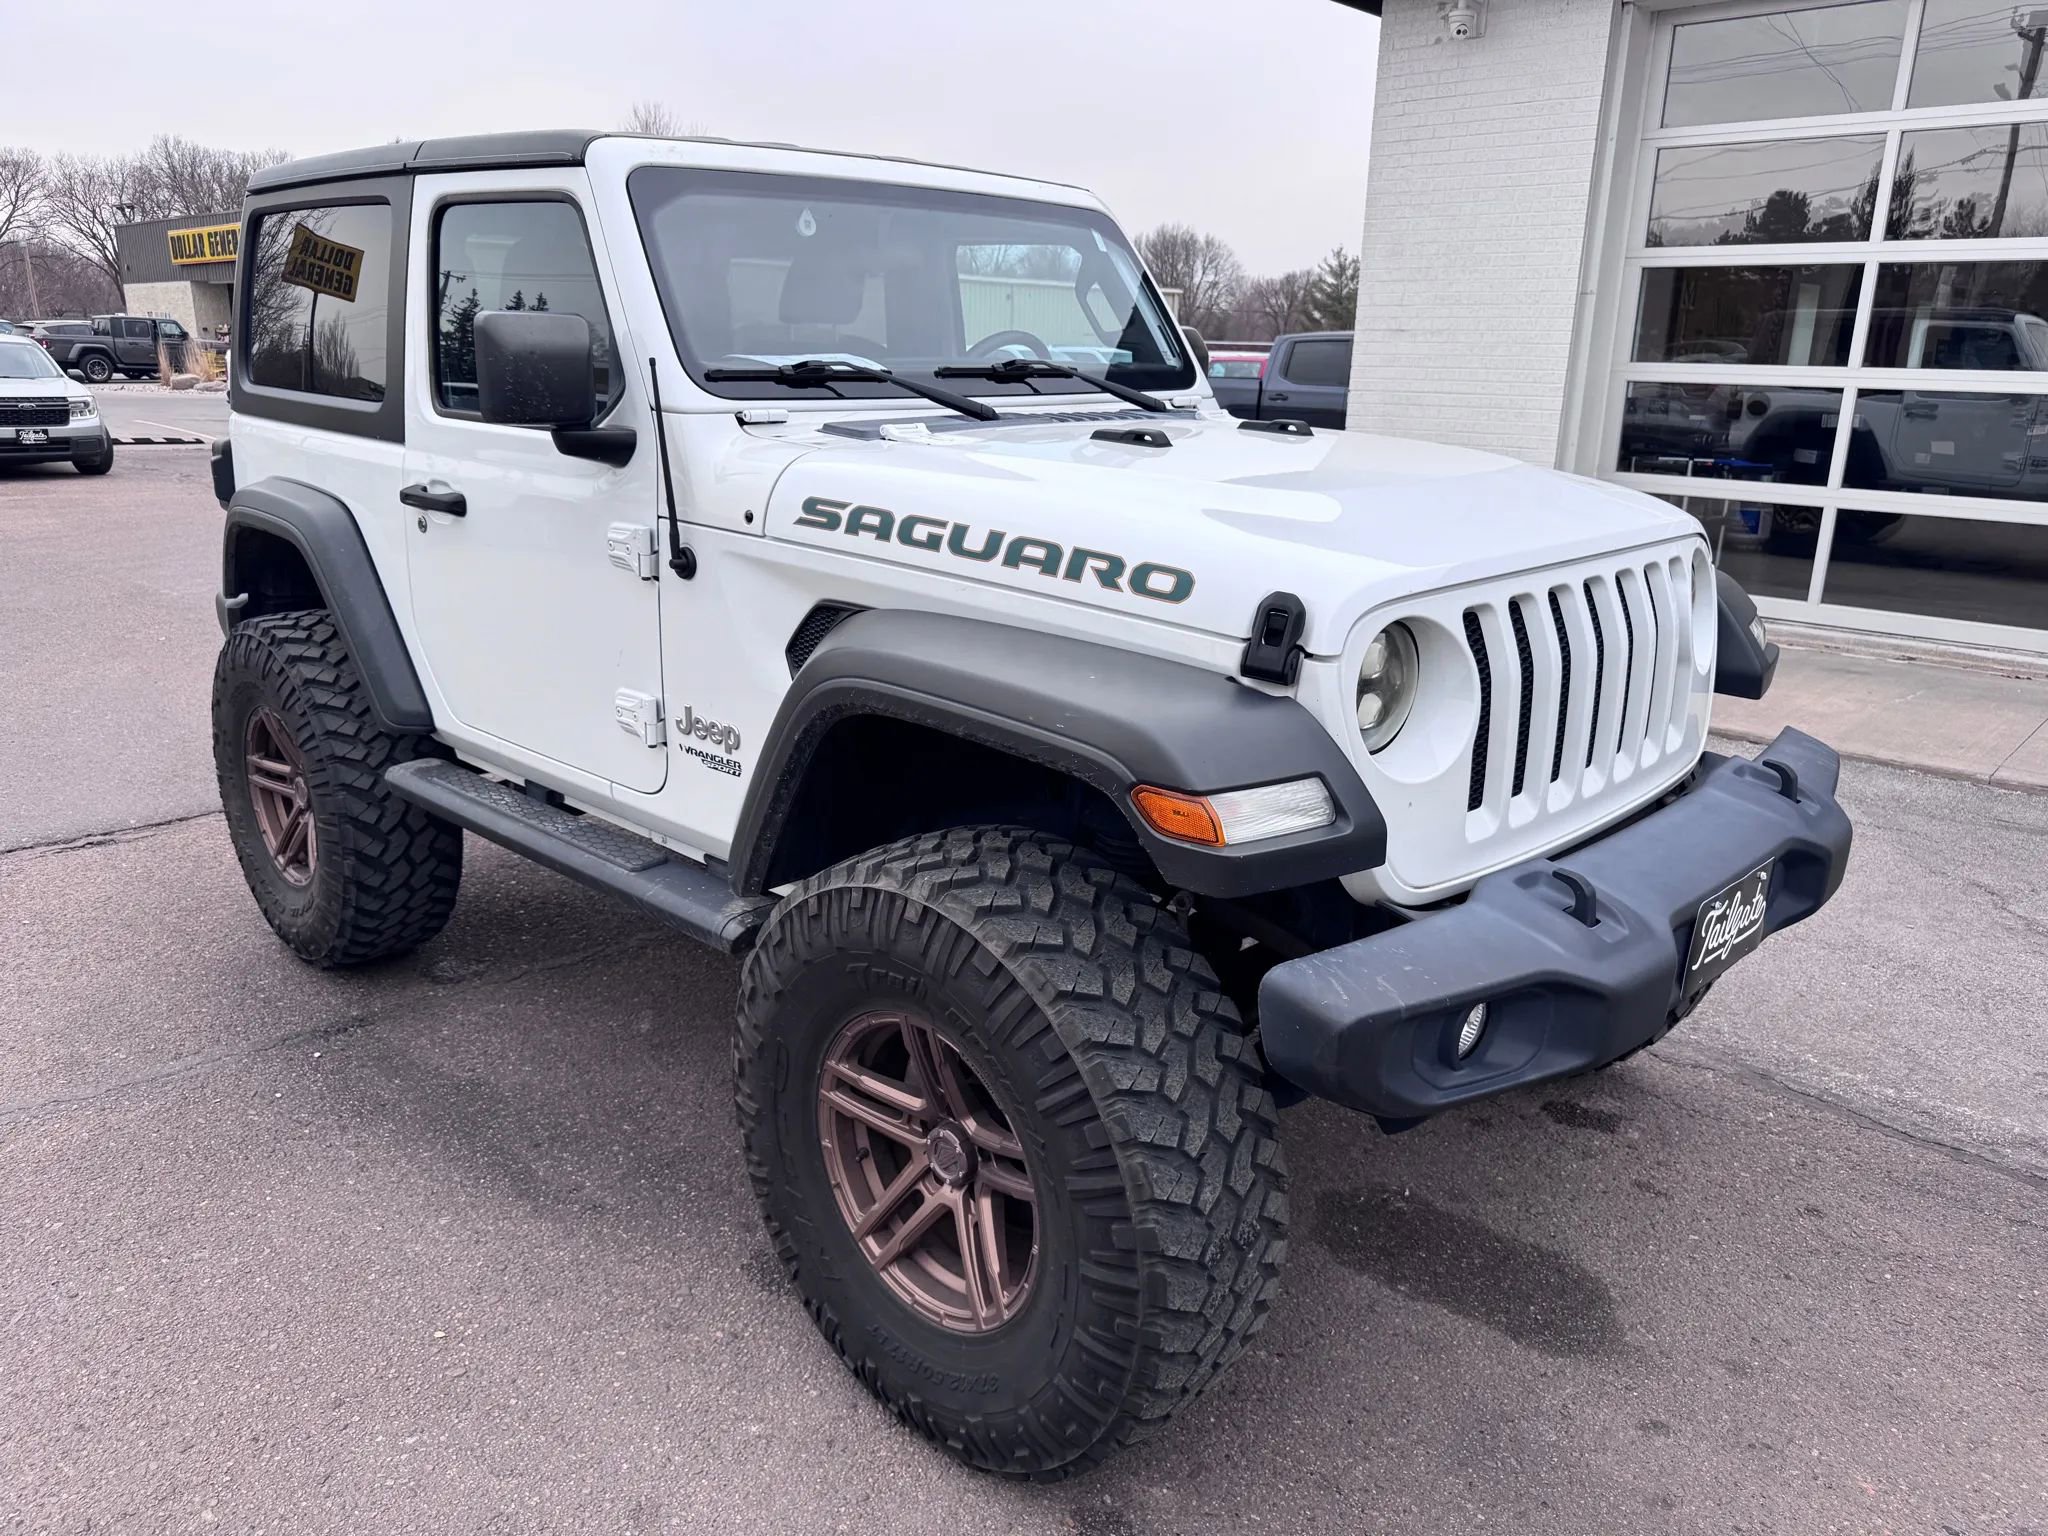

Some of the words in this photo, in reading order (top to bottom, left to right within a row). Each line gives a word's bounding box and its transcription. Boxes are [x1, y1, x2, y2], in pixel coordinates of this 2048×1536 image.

[170, 232, 206, 260] DOLLAR
[207, 228, 241, 258] GENER
[793, 495, 1196, 605] SAGUARO
[674, 703, 741, 755] Jeep
[679, 743, 742, 770] WRANGLER
[703, 761, 742, 777] SPORT
[1692, 882, 1767, 971] Tailgate
